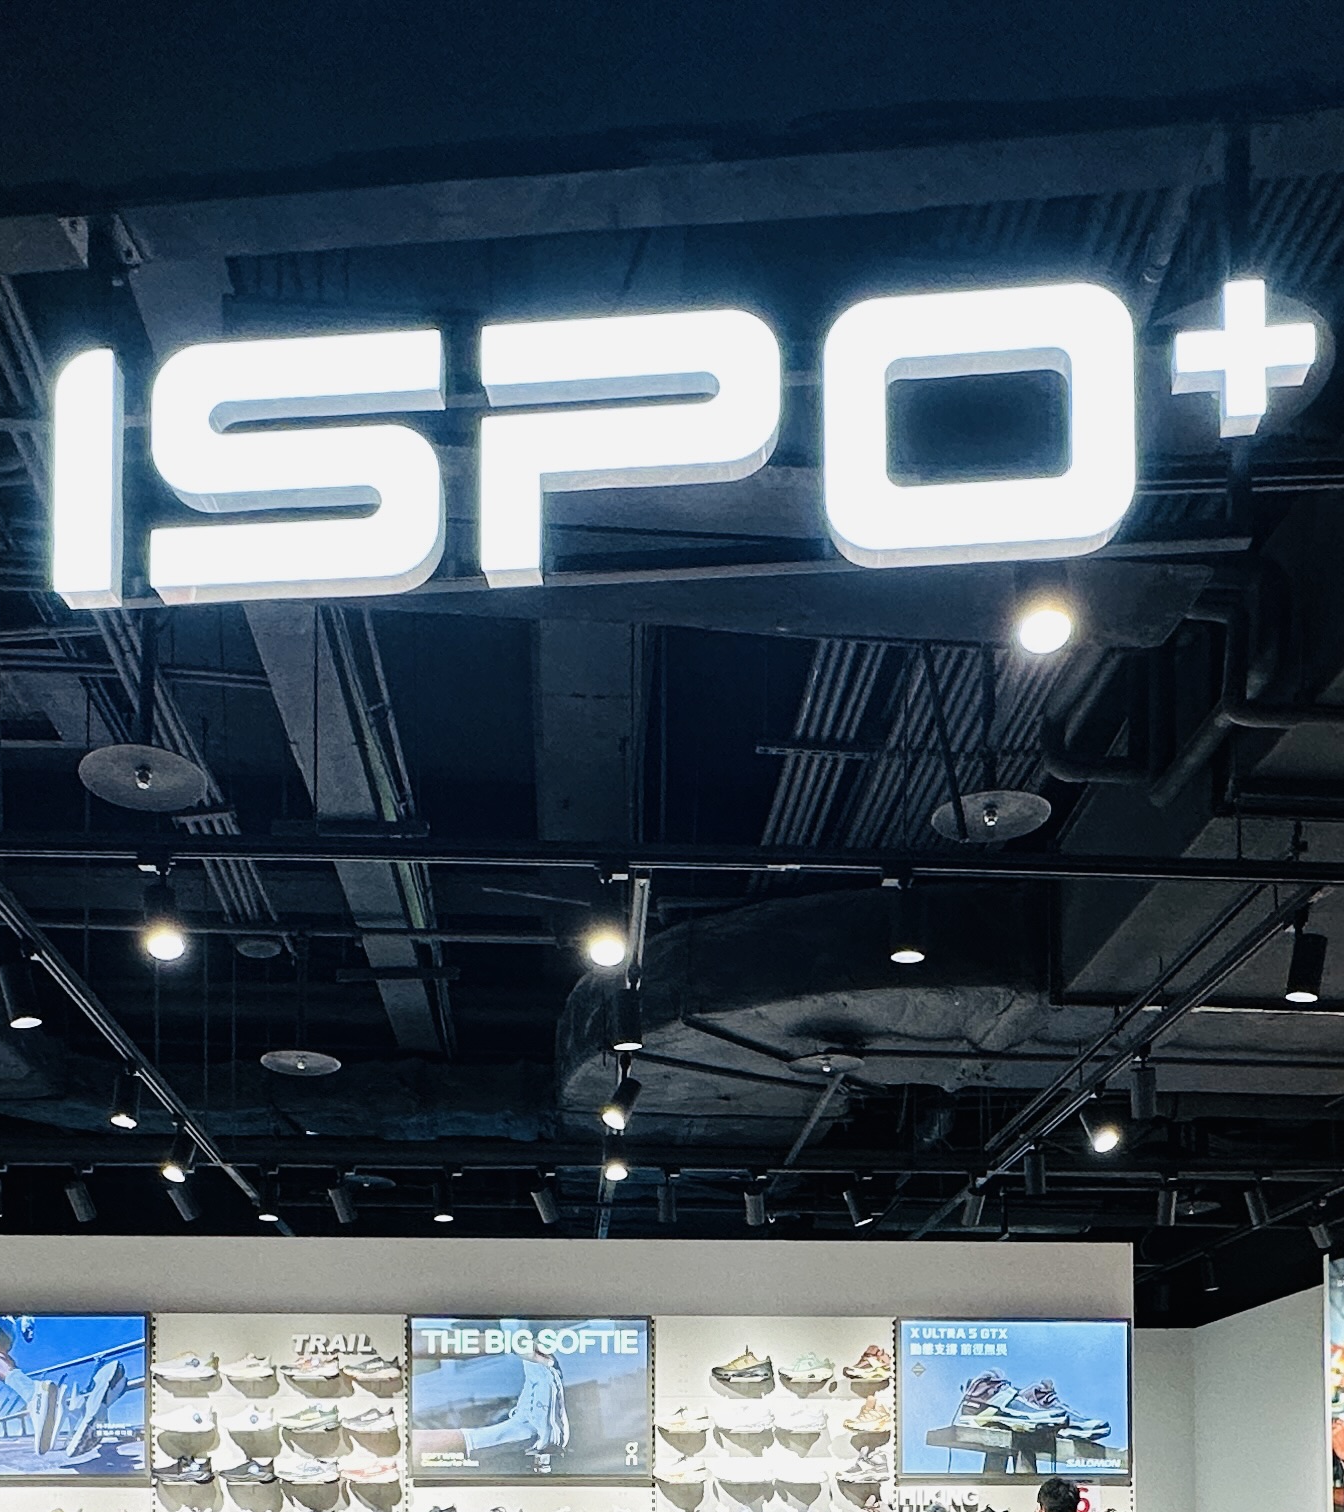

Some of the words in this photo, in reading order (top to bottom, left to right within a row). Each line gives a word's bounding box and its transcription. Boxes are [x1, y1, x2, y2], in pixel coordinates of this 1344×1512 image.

[910, 1328, 920, 1339] X
[922, 1328, 967, 1339] ULTRA
[968, 1328, 977, 1339] 5
[980, 1328, 1008, 1339] GTX
[292, 1333, 373, 1353] TRAIL
[421, 1329, 481, 1354] THE
[484, 1329, 534, 1354] BIG
[537, 1329, 638, 1354] SOFTIE
[1065, 1458, 1121, 1468] SALOMON
